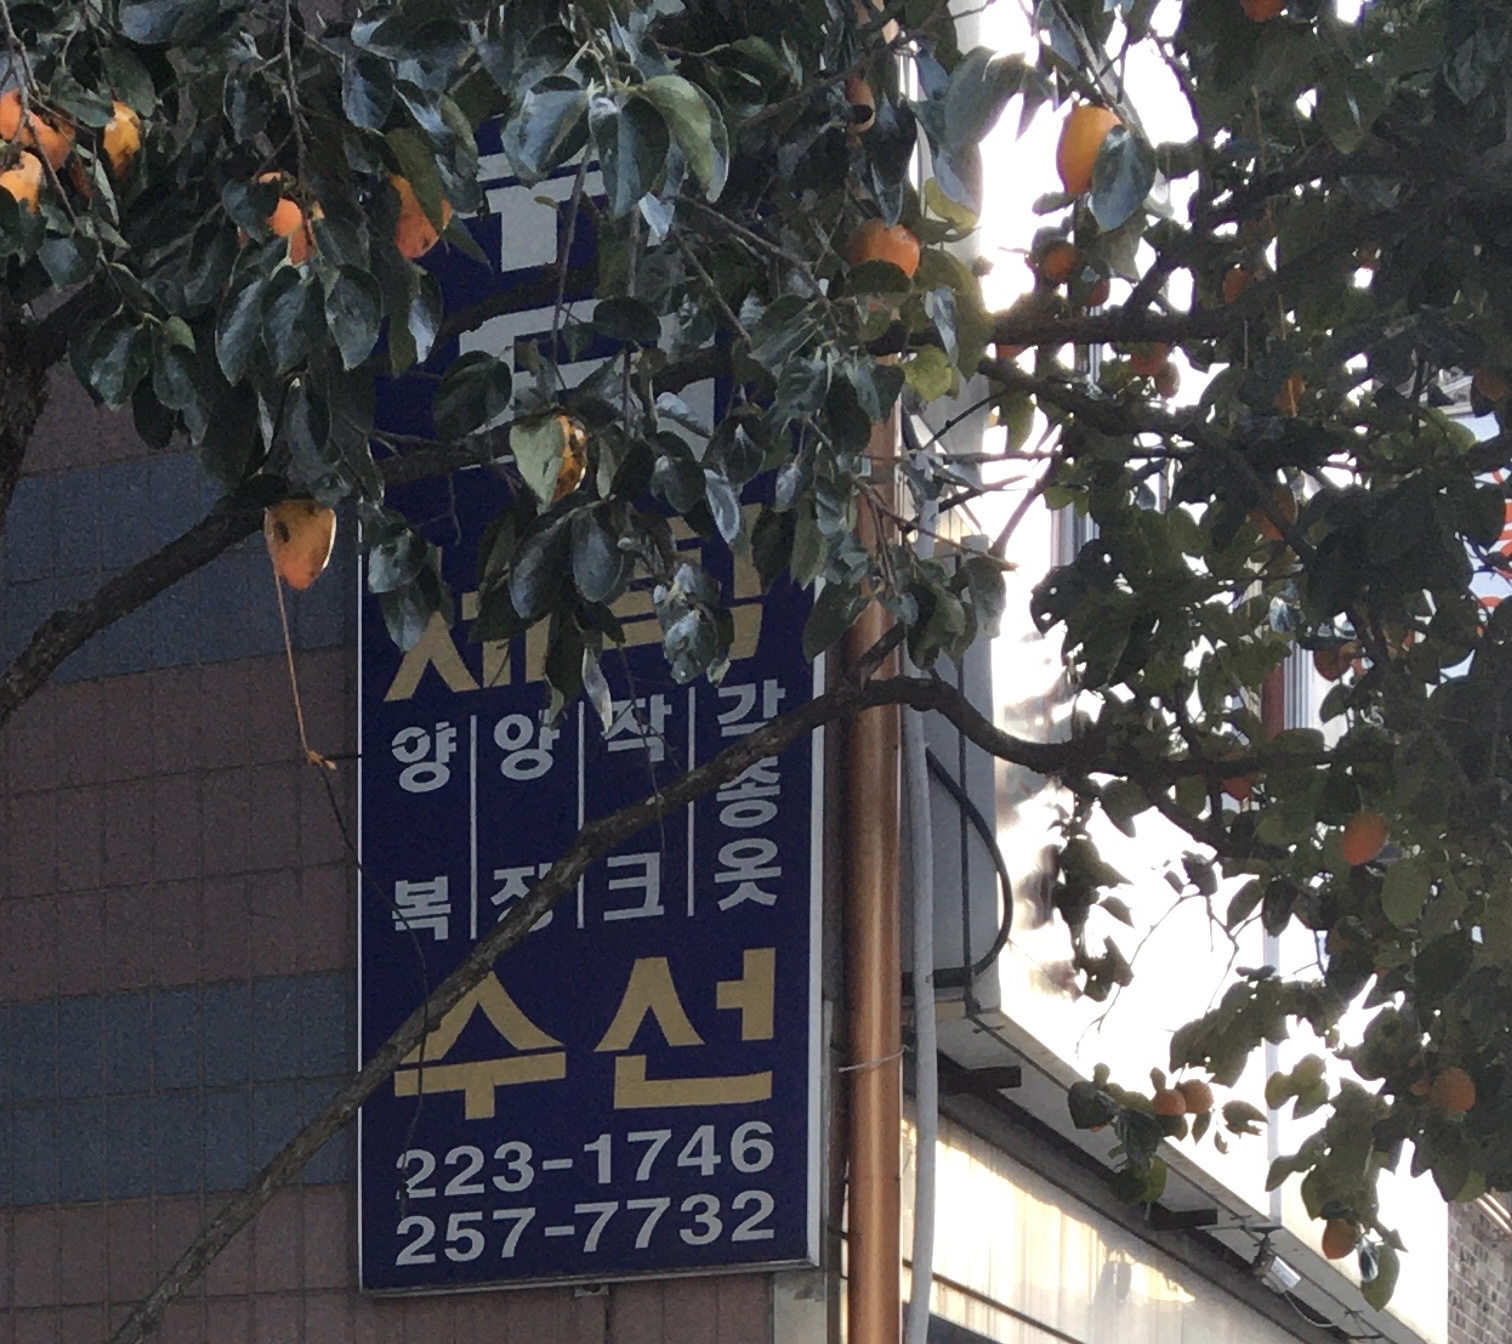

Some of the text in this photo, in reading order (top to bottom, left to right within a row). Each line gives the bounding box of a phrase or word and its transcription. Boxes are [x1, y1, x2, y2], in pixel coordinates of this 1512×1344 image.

[391, 721, 456, 941] 양복
[394, 947, 777, 1121] 수선
[395, 1120, 775, 1201] 223-1746
[395, 1189, 776, 1267] 257-7732
